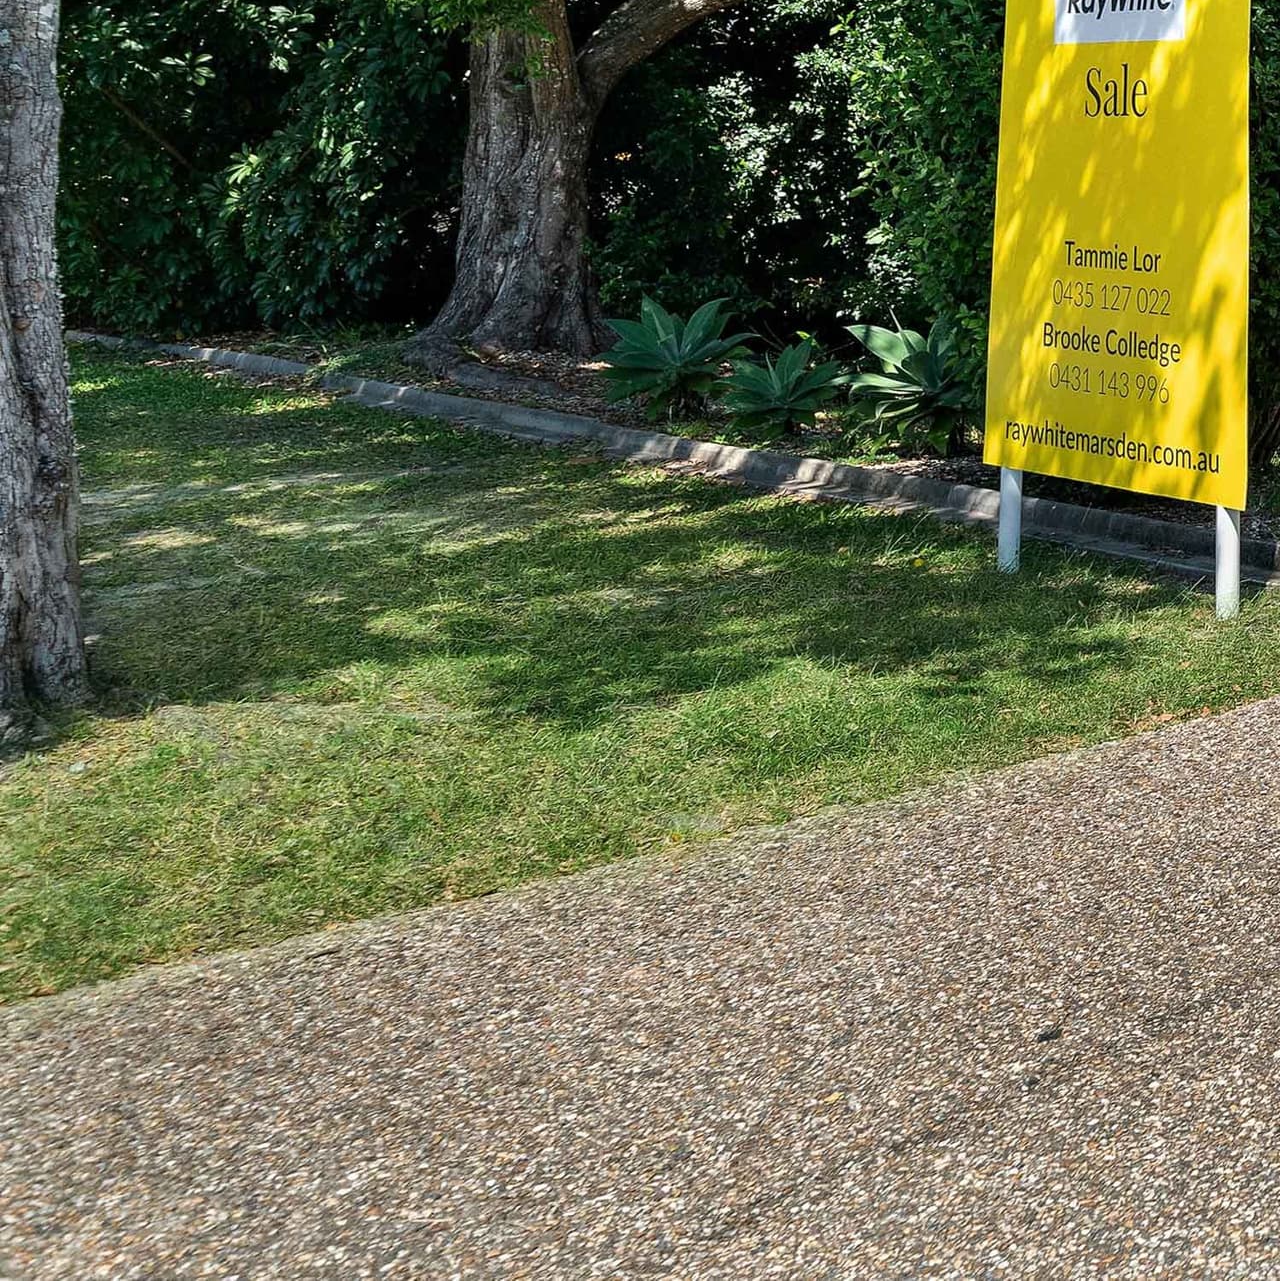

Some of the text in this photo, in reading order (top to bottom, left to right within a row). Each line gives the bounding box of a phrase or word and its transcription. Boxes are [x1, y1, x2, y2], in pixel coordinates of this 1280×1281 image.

[1085, 62, 1147, 117] Sale
[1065, 240, 1161, 273] Tammie Lor
[1053, 279, 1171, 316] 0435 127 022
[1043, 322, 1181, 367] Brooke Colledge
[1050, 363, 1169, 404] 0431 143 996
[1005, 419, 1220, 474] raywhitemarsden.com.au
